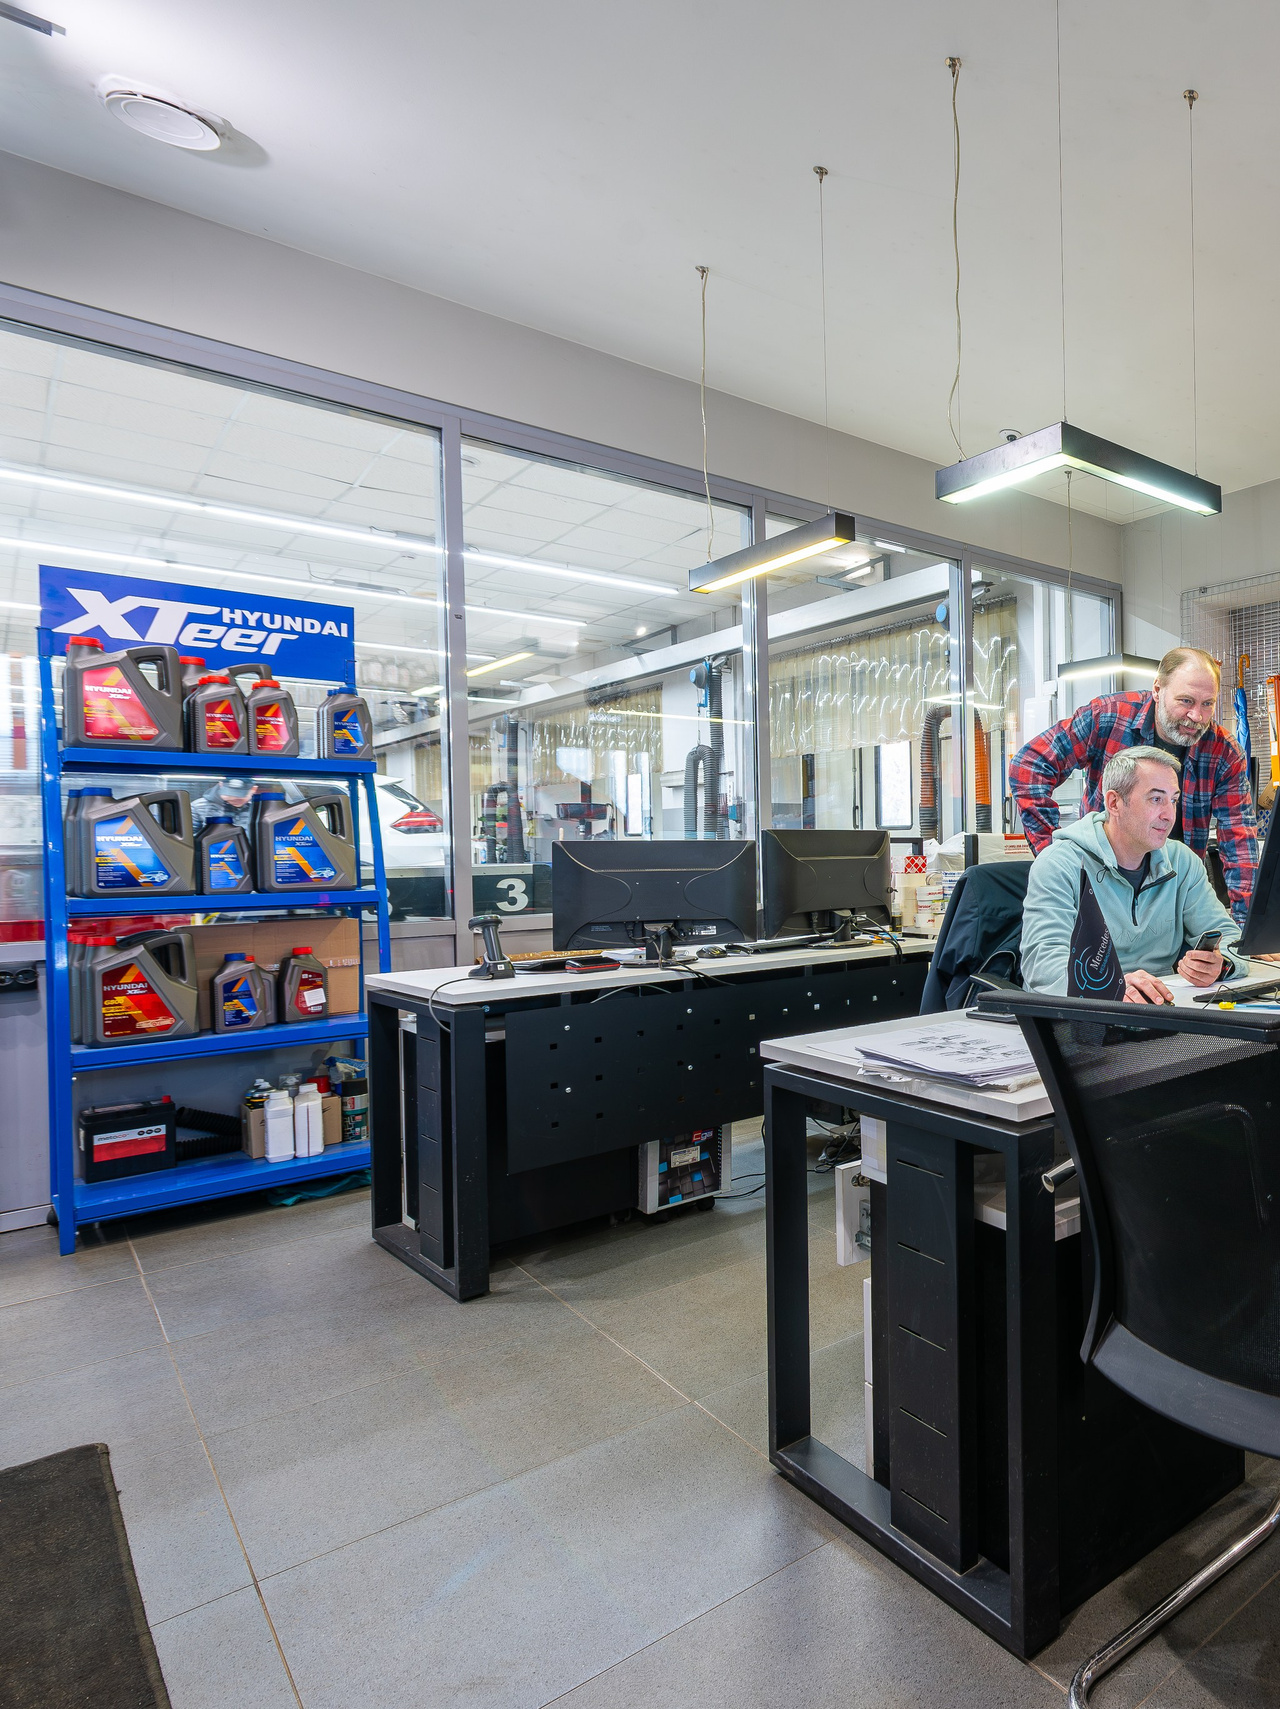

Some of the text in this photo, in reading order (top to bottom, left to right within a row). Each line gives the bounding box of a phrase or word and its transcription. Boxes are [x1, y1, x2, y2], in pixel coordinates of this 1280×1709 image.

[53, 587, 299, 655] XTeer
[222, 608, 348, 638] HYUNDAI
[85, 685, 131, 694] HYUNDAI
[496, 877, 529, 912] 3
[103, 983, 148, 991] HYUNDAI
